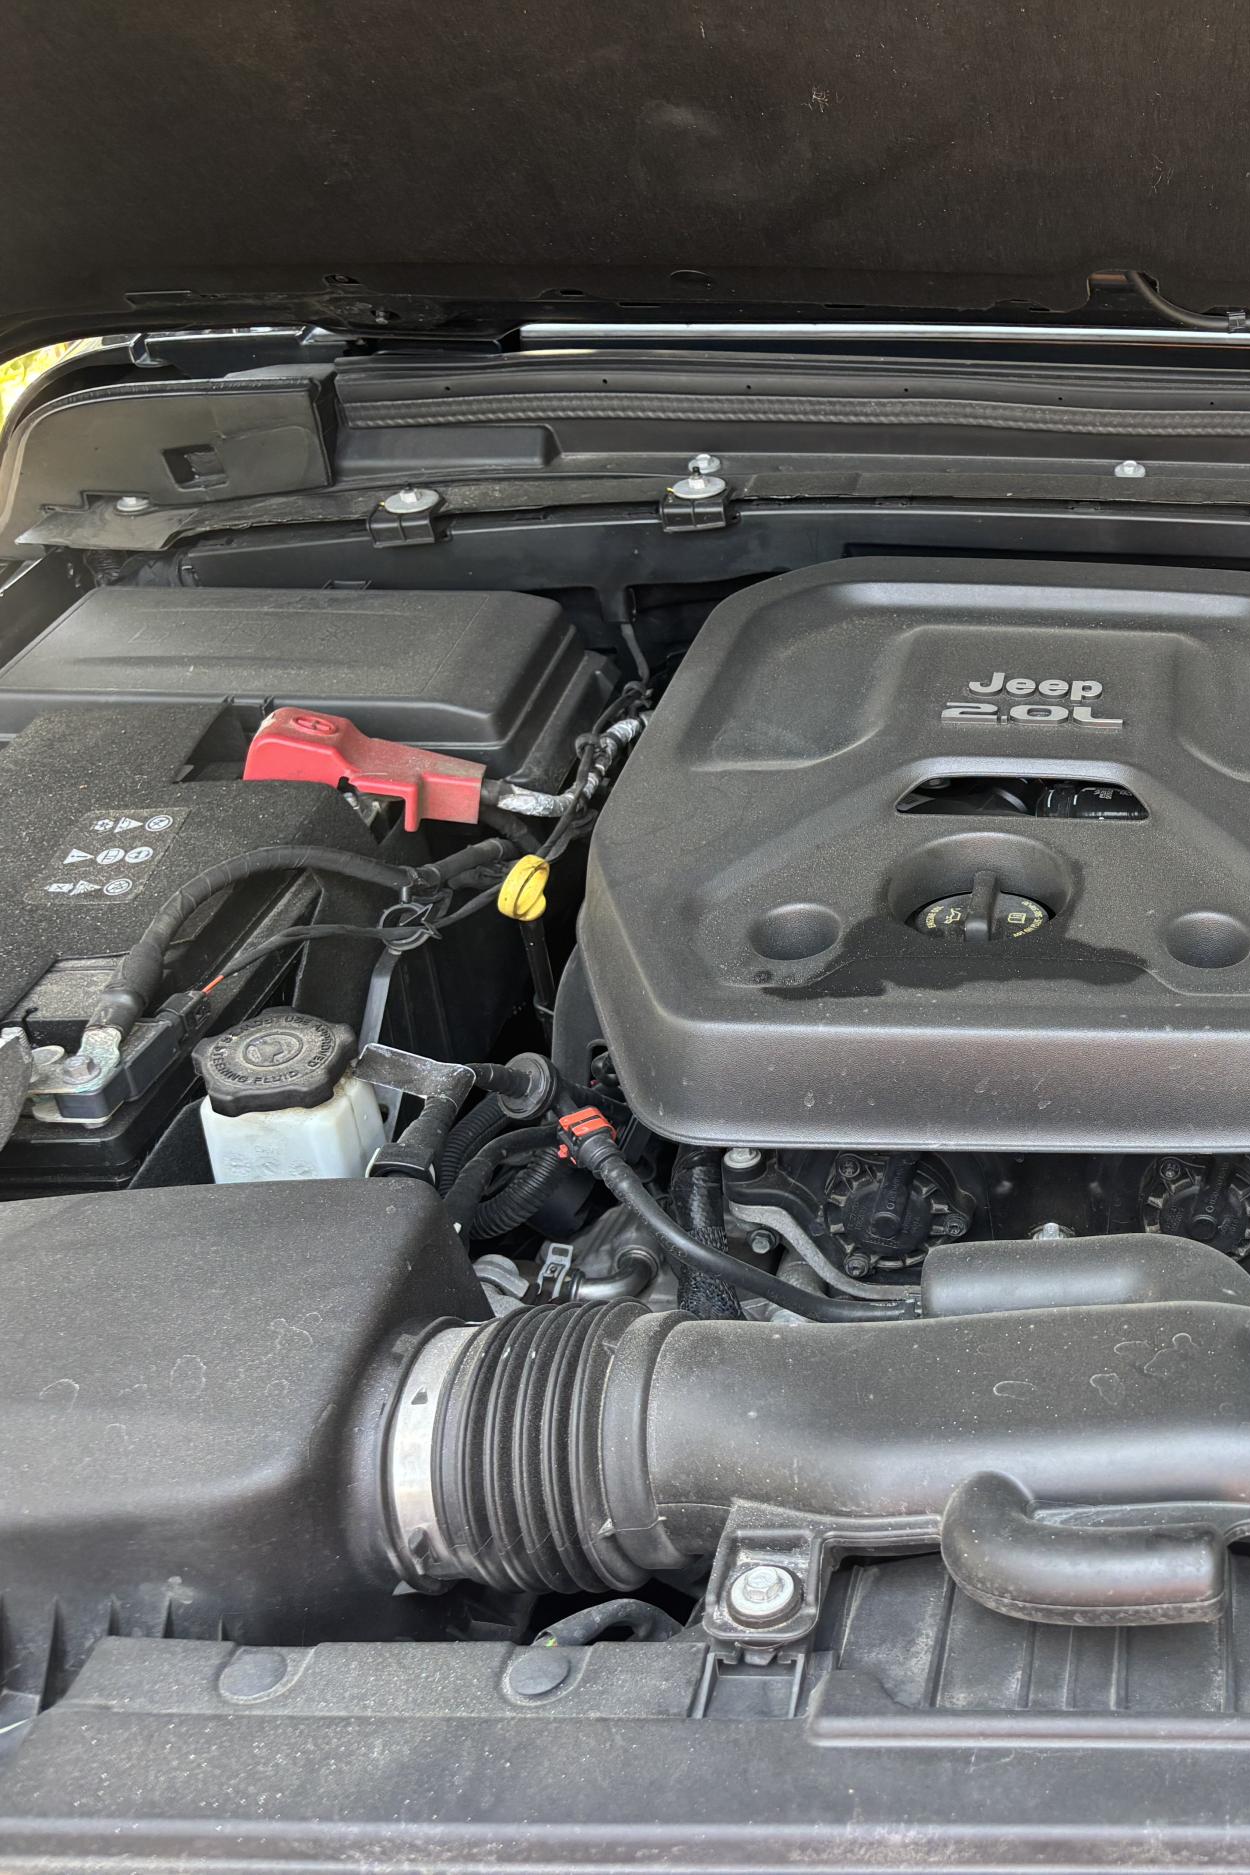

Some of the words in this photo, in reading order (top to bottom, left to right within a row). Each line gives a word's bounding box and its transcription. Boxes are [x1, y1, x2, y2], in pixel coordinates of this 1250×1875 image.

[969, 672, 1103, 705] Jeep
[941, 702, 1124, 729] 2.0L
[212, 1045, 249, 1084] STEERING
[253, 1070, 299, 1084] FLUID
